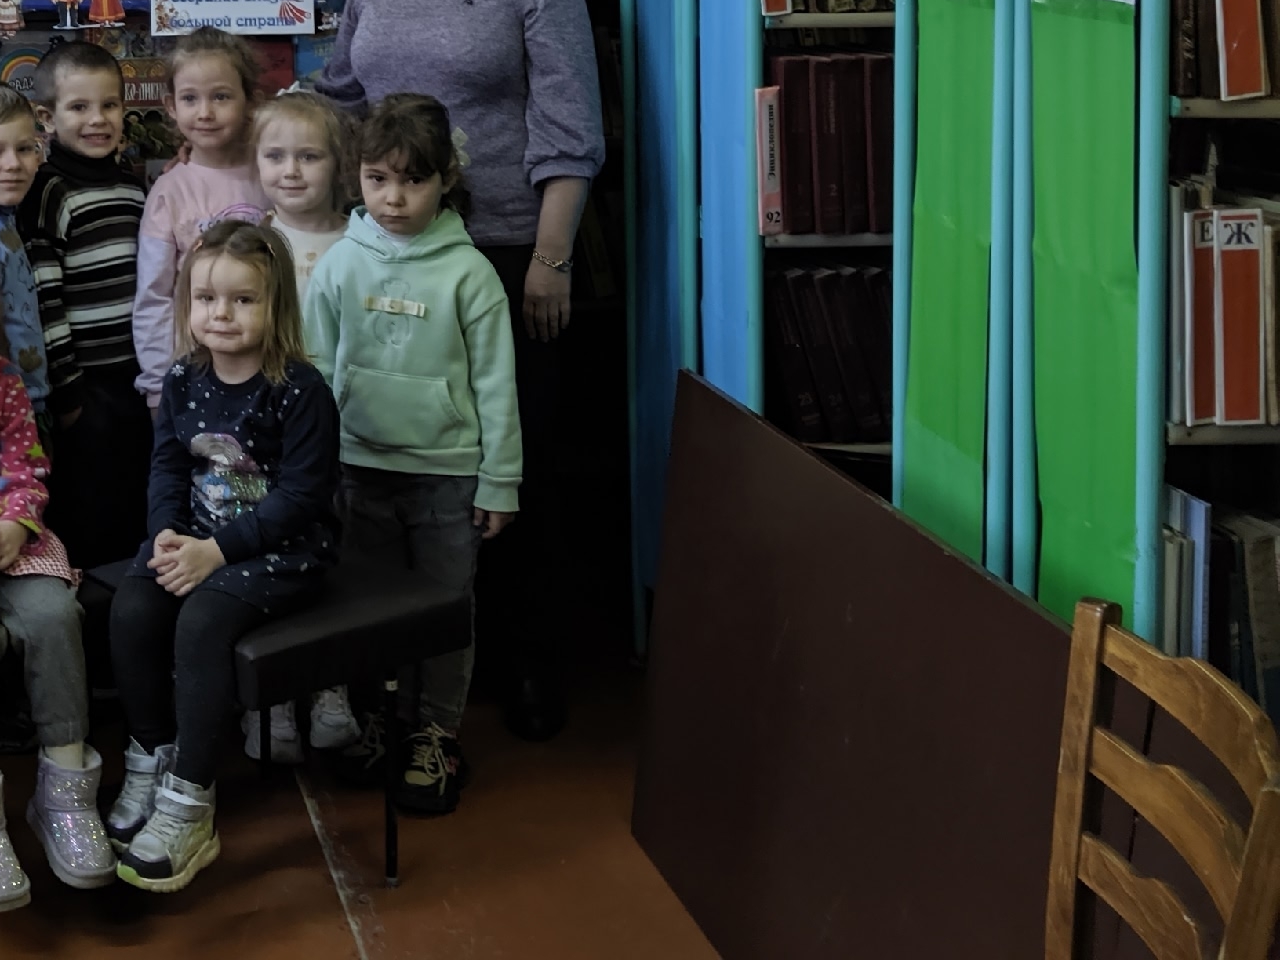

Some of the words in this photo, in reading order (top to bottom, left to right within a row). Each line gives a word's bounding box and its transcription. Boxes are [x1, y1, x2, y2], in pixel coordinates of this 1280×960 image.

[170, 16, 232, 28] большой
[236, 16, 296, 29] страны
[766, 211, 781, 223] 92
[1199, 219, 1213, 242] Е
[1223, 221, 1255, 245] Ж
